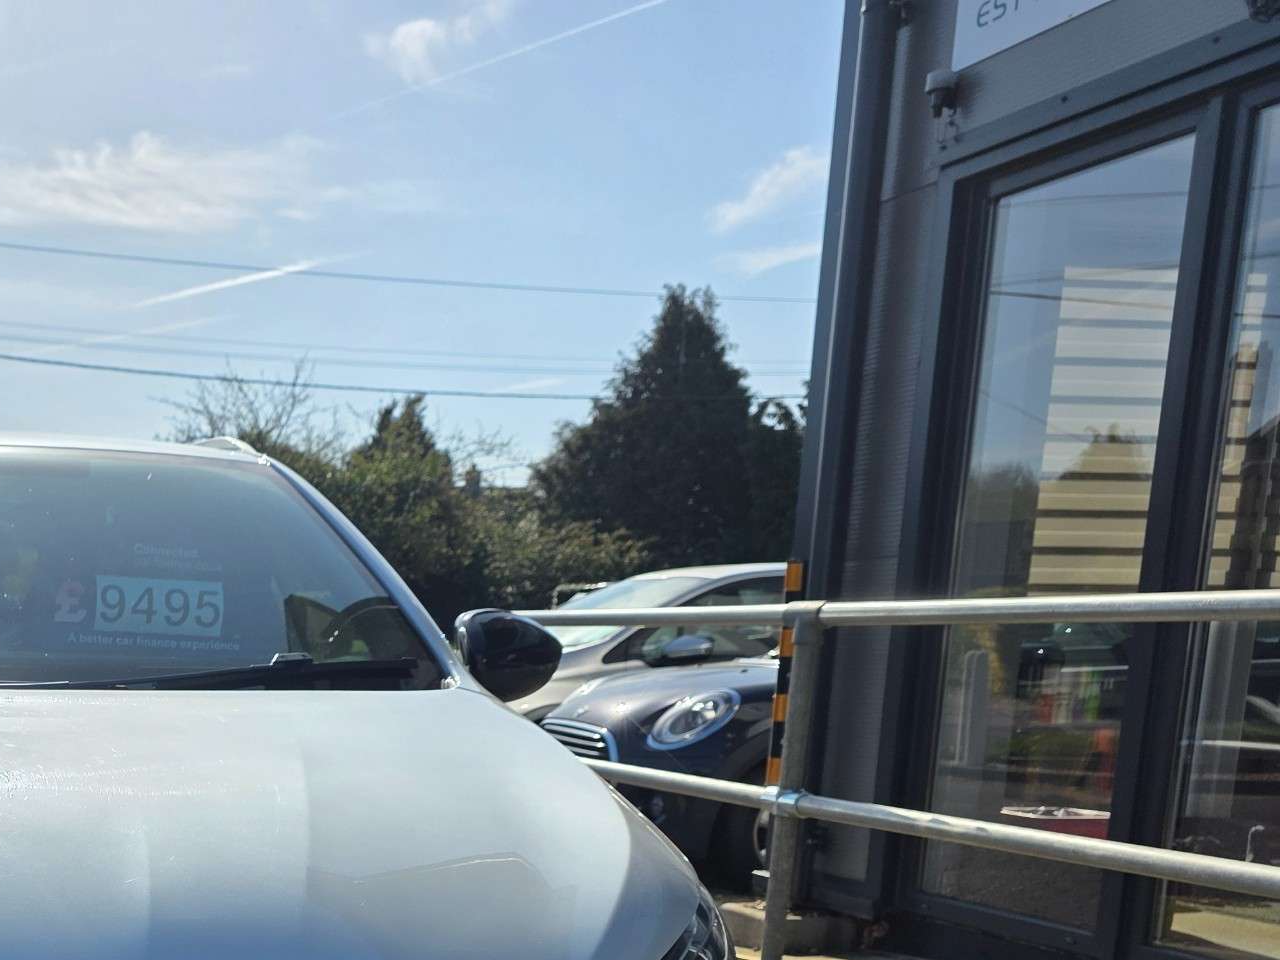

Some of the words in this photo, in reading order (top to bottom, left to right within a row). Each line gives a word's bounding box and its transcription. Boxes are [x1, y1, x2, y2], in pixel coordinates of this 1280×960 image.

[99, 584, 220, 628] 9495
[67, 633, 77, 643] A
[79, 633, 115, 645] better
[116, 636, 134, 646] car
[136, 635, 177, 648] finance
[179, 639, 240, 652] experience
